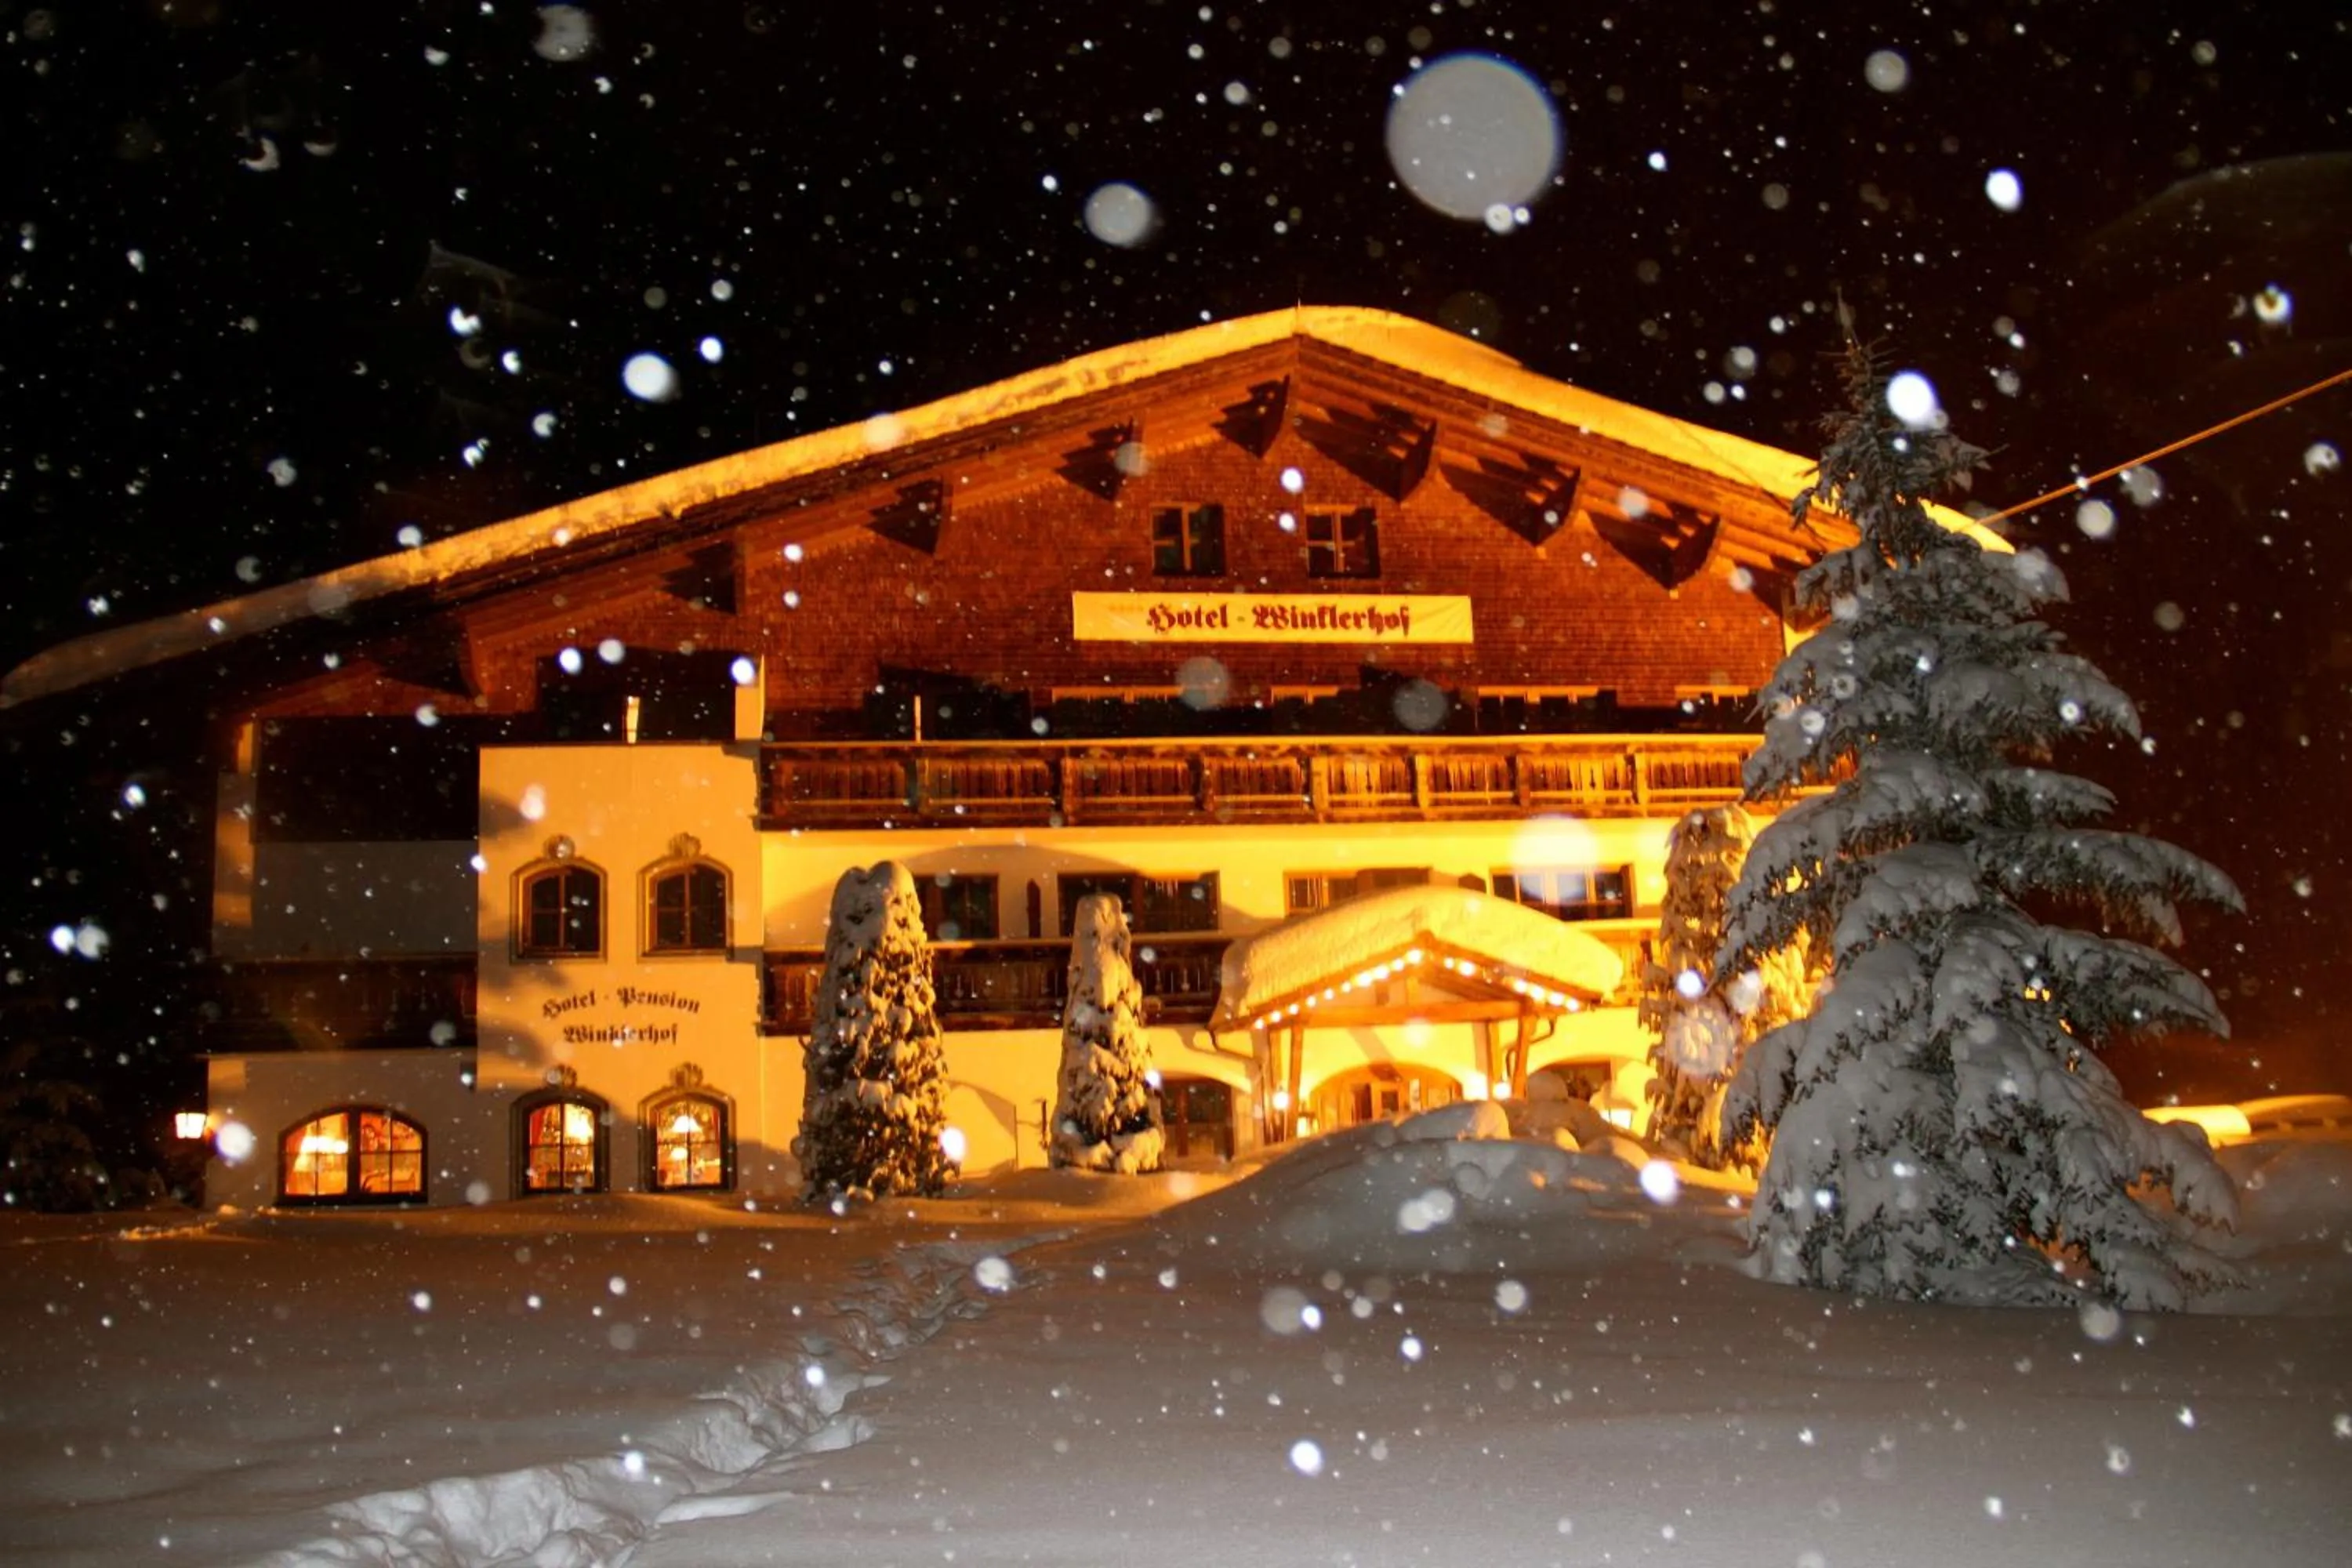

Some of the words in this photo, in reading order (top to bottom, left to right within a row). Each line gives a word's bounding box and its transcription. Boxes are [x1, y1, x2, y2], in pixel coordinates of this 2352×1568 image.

[1145, 603, 1229, 634] Hotel
[1252, 604, 1410, 637] Winklerhof
[542, 989, 596, 1020] Hotel
[616, 985, 700, 1014] Pension
